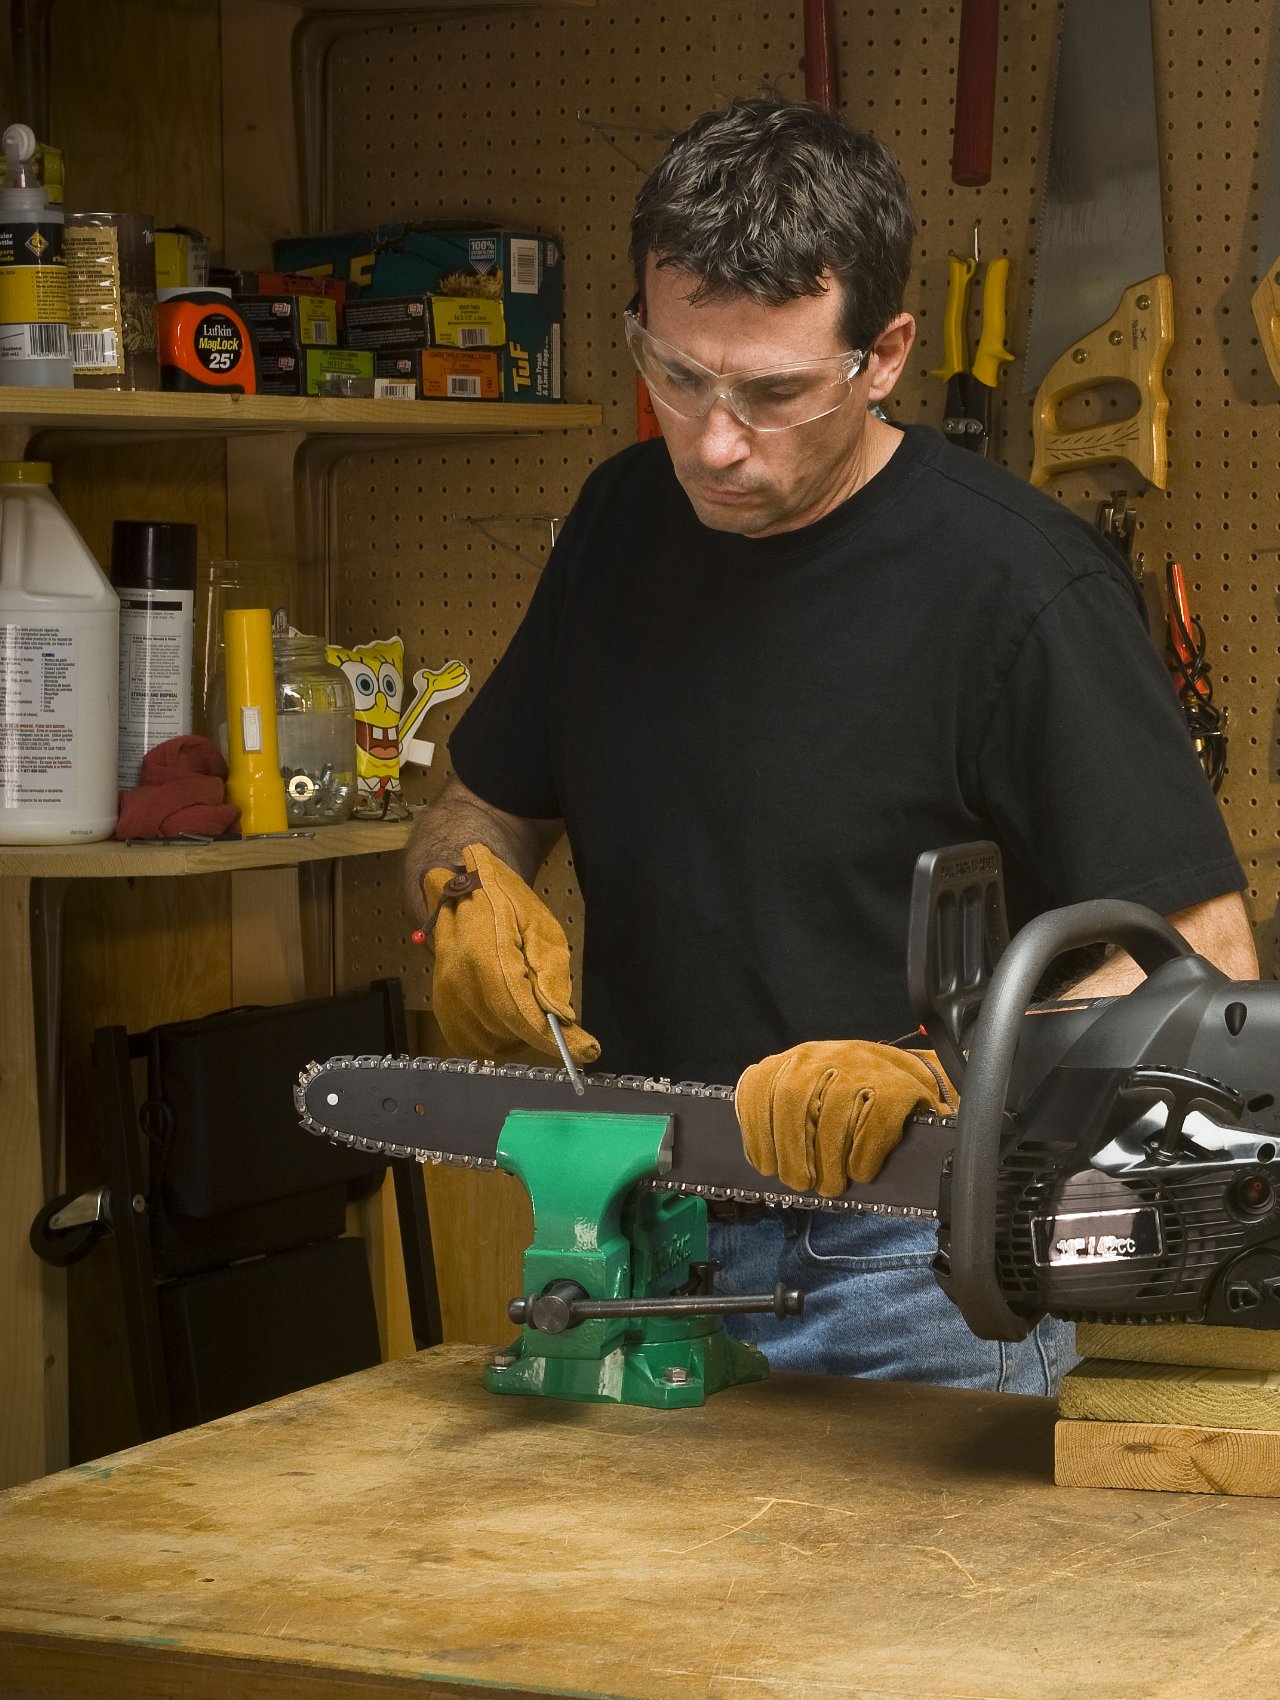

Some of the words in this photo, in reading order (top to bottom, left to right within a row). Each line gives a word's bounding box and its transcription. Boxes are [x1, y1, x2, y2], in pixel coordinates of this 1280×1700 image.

[470, 240, 495, 251] 100%
[203, 324, 232, 337] Lufkin
[198, 337, 239, 352] MagLock
[209, 353, 234, 369] 25'
[509, 341, 531, 393] TuF
[535, 352, 543, 373] Trash
[535, 375, 543, 396] Large
